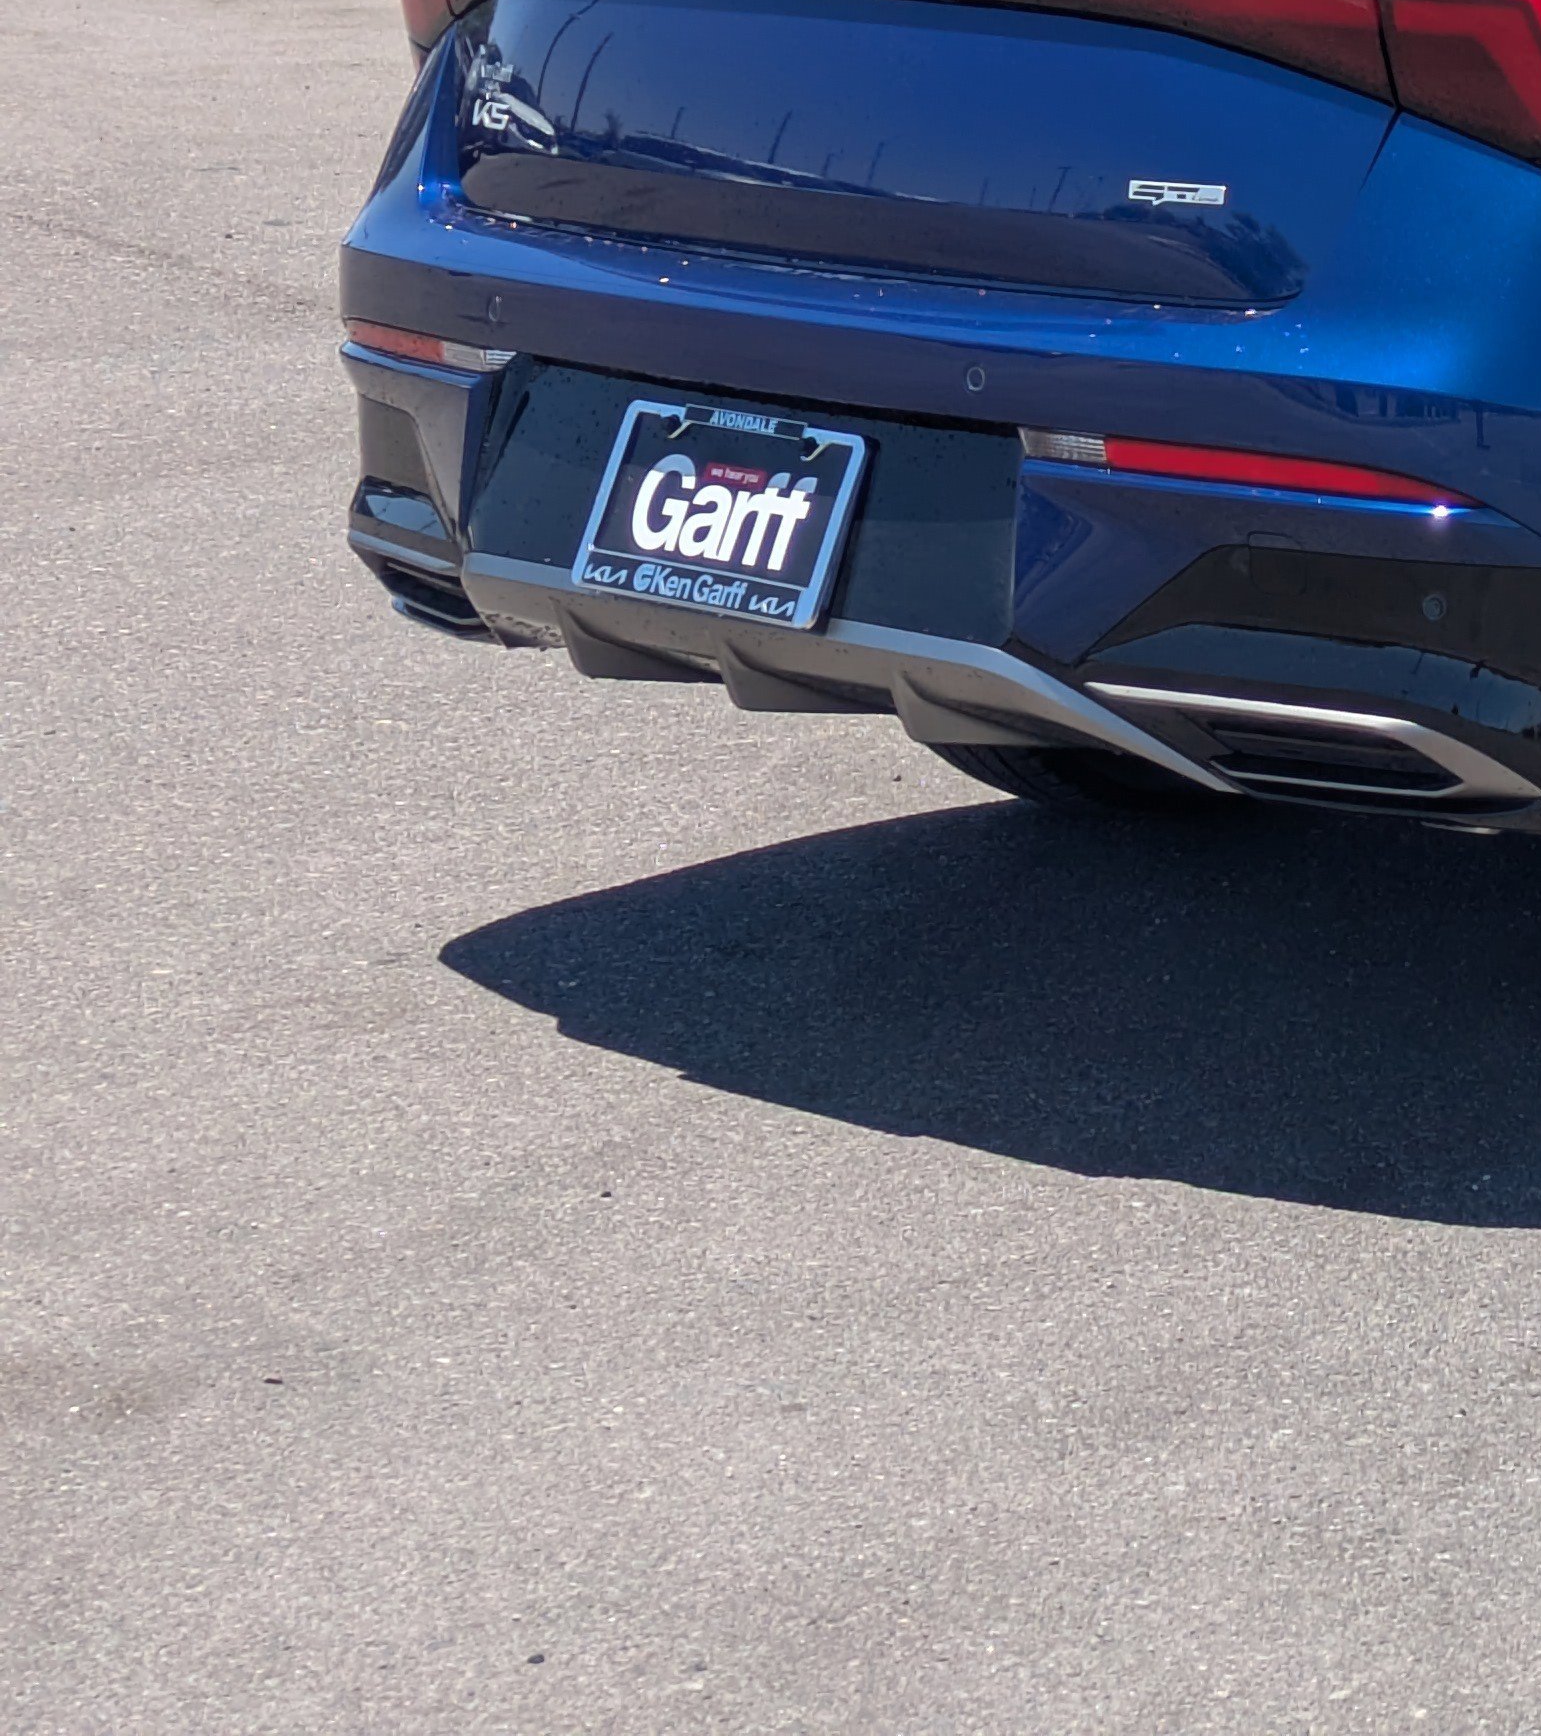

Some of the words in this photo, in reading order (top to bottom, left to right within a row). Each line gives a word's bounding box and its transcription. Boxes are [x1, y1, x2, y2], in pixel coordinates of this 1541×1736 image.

[472, 99, 509, 130] K5
[709, 409, 778, 434] AVONDALE
[632, 454, 817, 571] Garff
[650, 565, 692, 600] Ken
[693, 575, 749, 610] Garff
